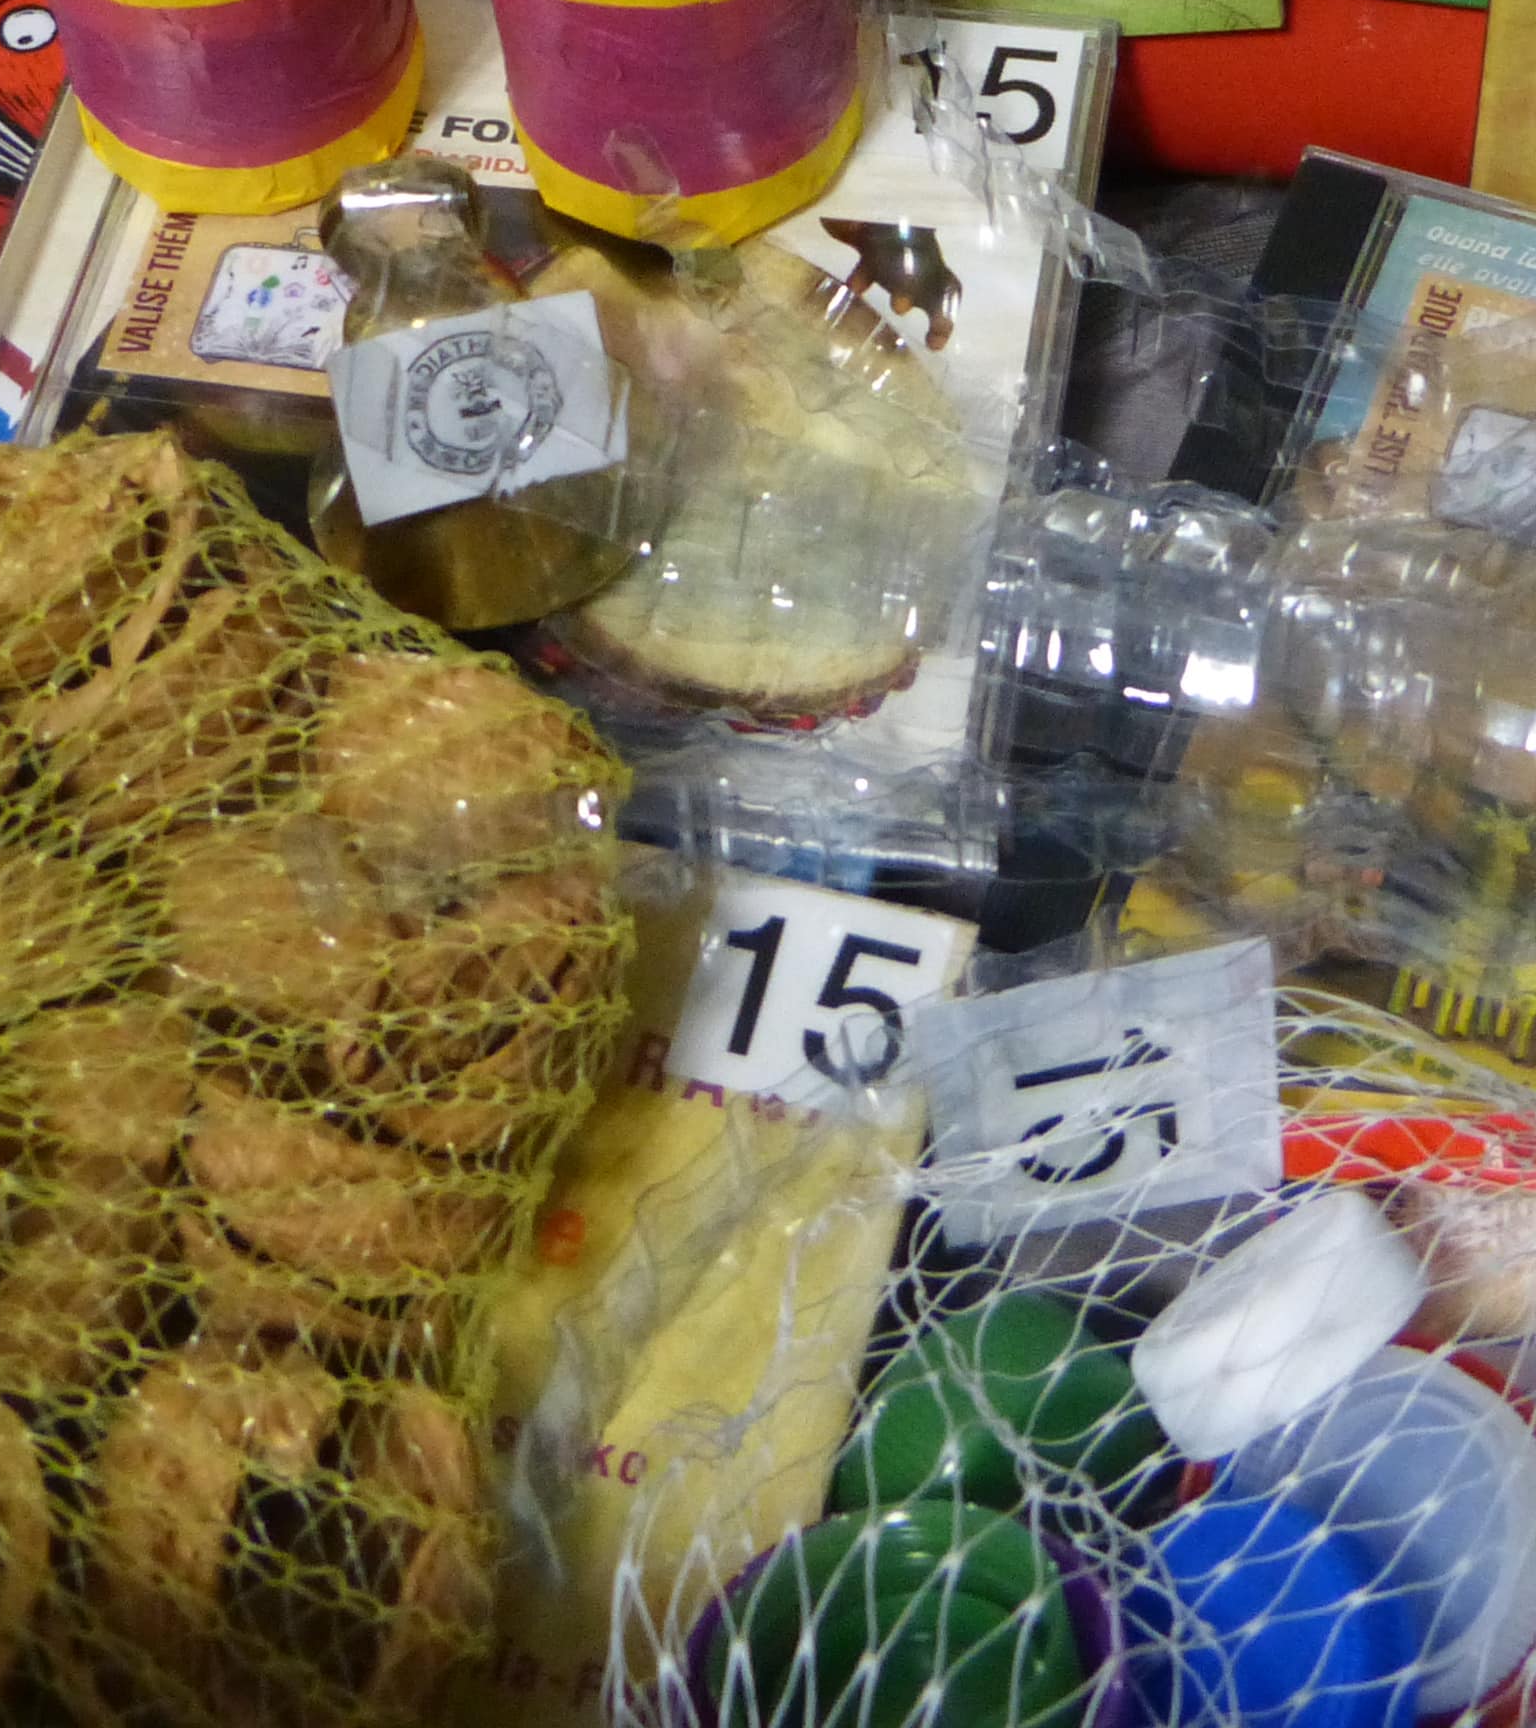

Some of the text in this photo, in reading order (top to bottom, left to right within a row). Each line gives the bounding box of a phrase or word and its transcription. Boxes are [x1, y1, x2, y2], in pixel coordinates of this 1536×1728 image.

[441, 116, 519, 144] FO
[1426, 225, 1511, 260] Quand
[117, 276, 174, 353] VALISE
[726, 915, 921, 1083] 15
[1015, 1028, 1181, 1183] 15
